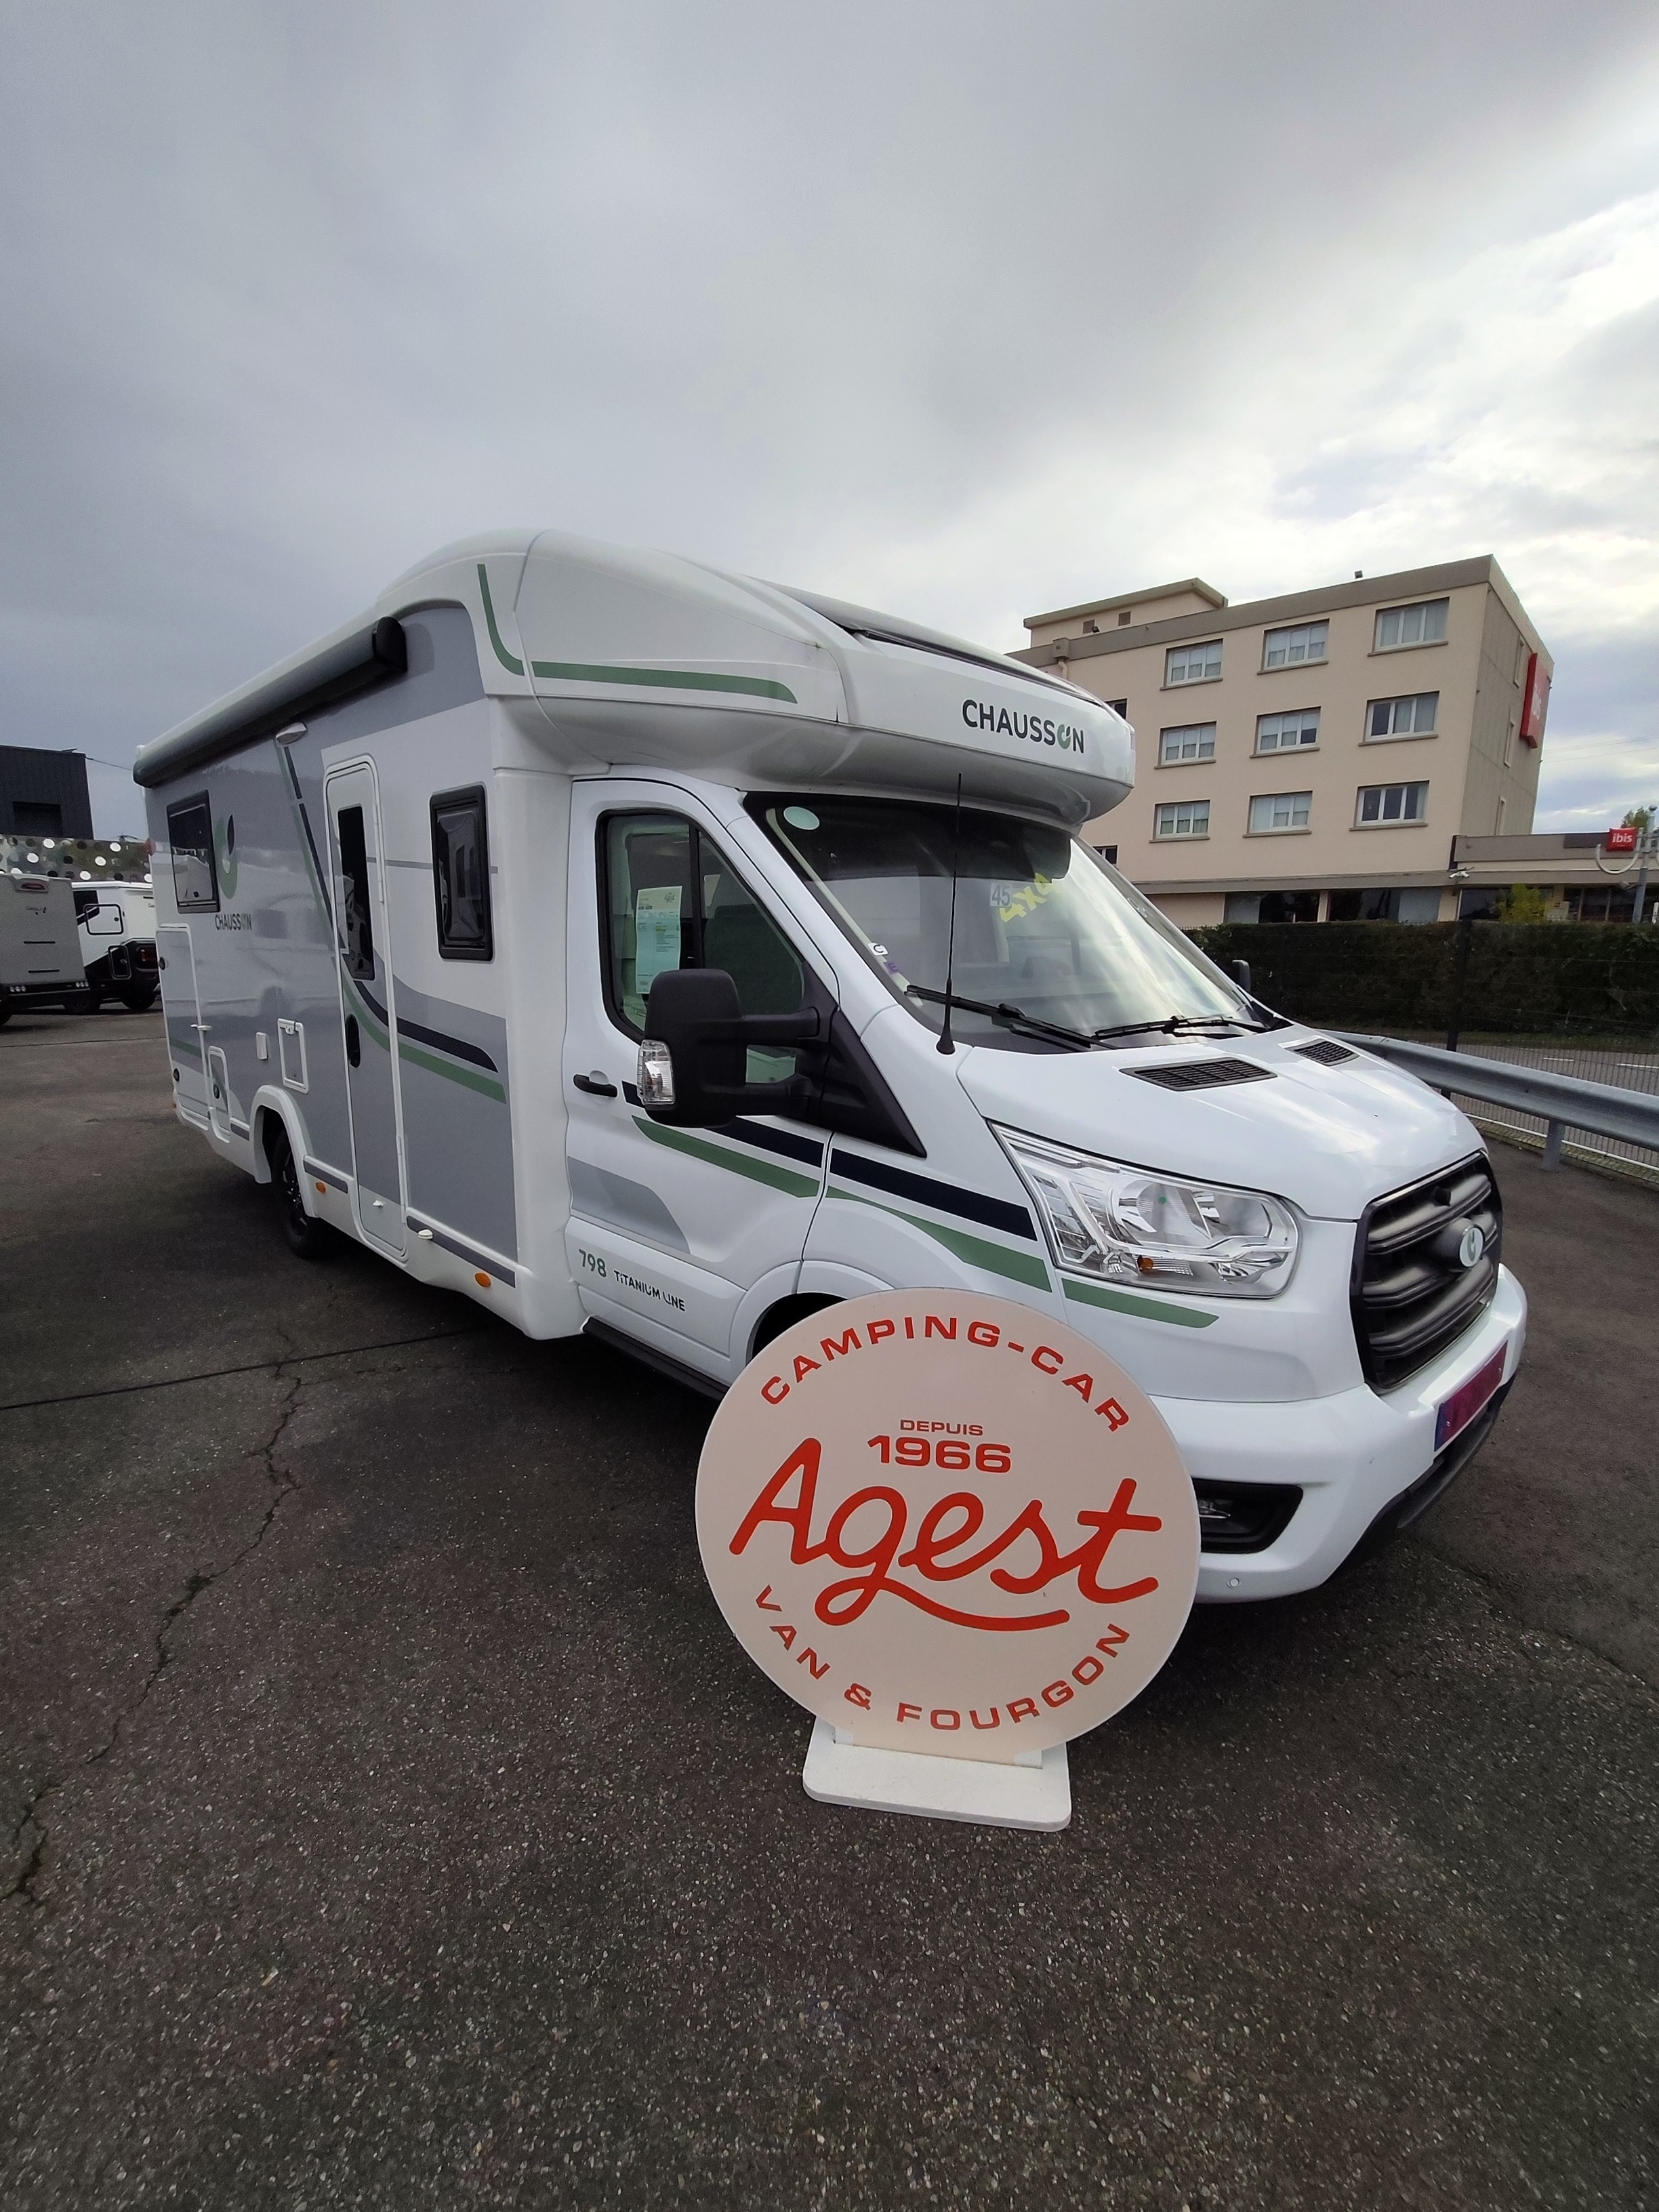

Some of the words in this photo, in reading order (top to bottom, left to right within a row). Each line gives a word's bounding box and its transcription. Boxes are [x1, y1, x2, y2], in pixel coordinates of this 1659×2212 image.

[962, 699, 1084, 754] CHAUSSON
[1612, 833, 1633, 843] ibis
[991, 884, 1011, 907] 45
[579, 1248, 607, 1278] 798
[613, 1269, 661, 1300] TITANIUM
[662, 1291, 686, 1312] LINE
[760, 1315, 1130, 1433] CAMPING-CAR
[900, 1419, 984, 1436] DEPUIS
[867, 1435, 1012, 1474] 1966
[729, 1437, 1163, 1633] Agest
[756, 1584, 830, 1681] VAN
[844, 1682, 873, 1711] &
[897, 1623, 1130, 1731] FOURGON
